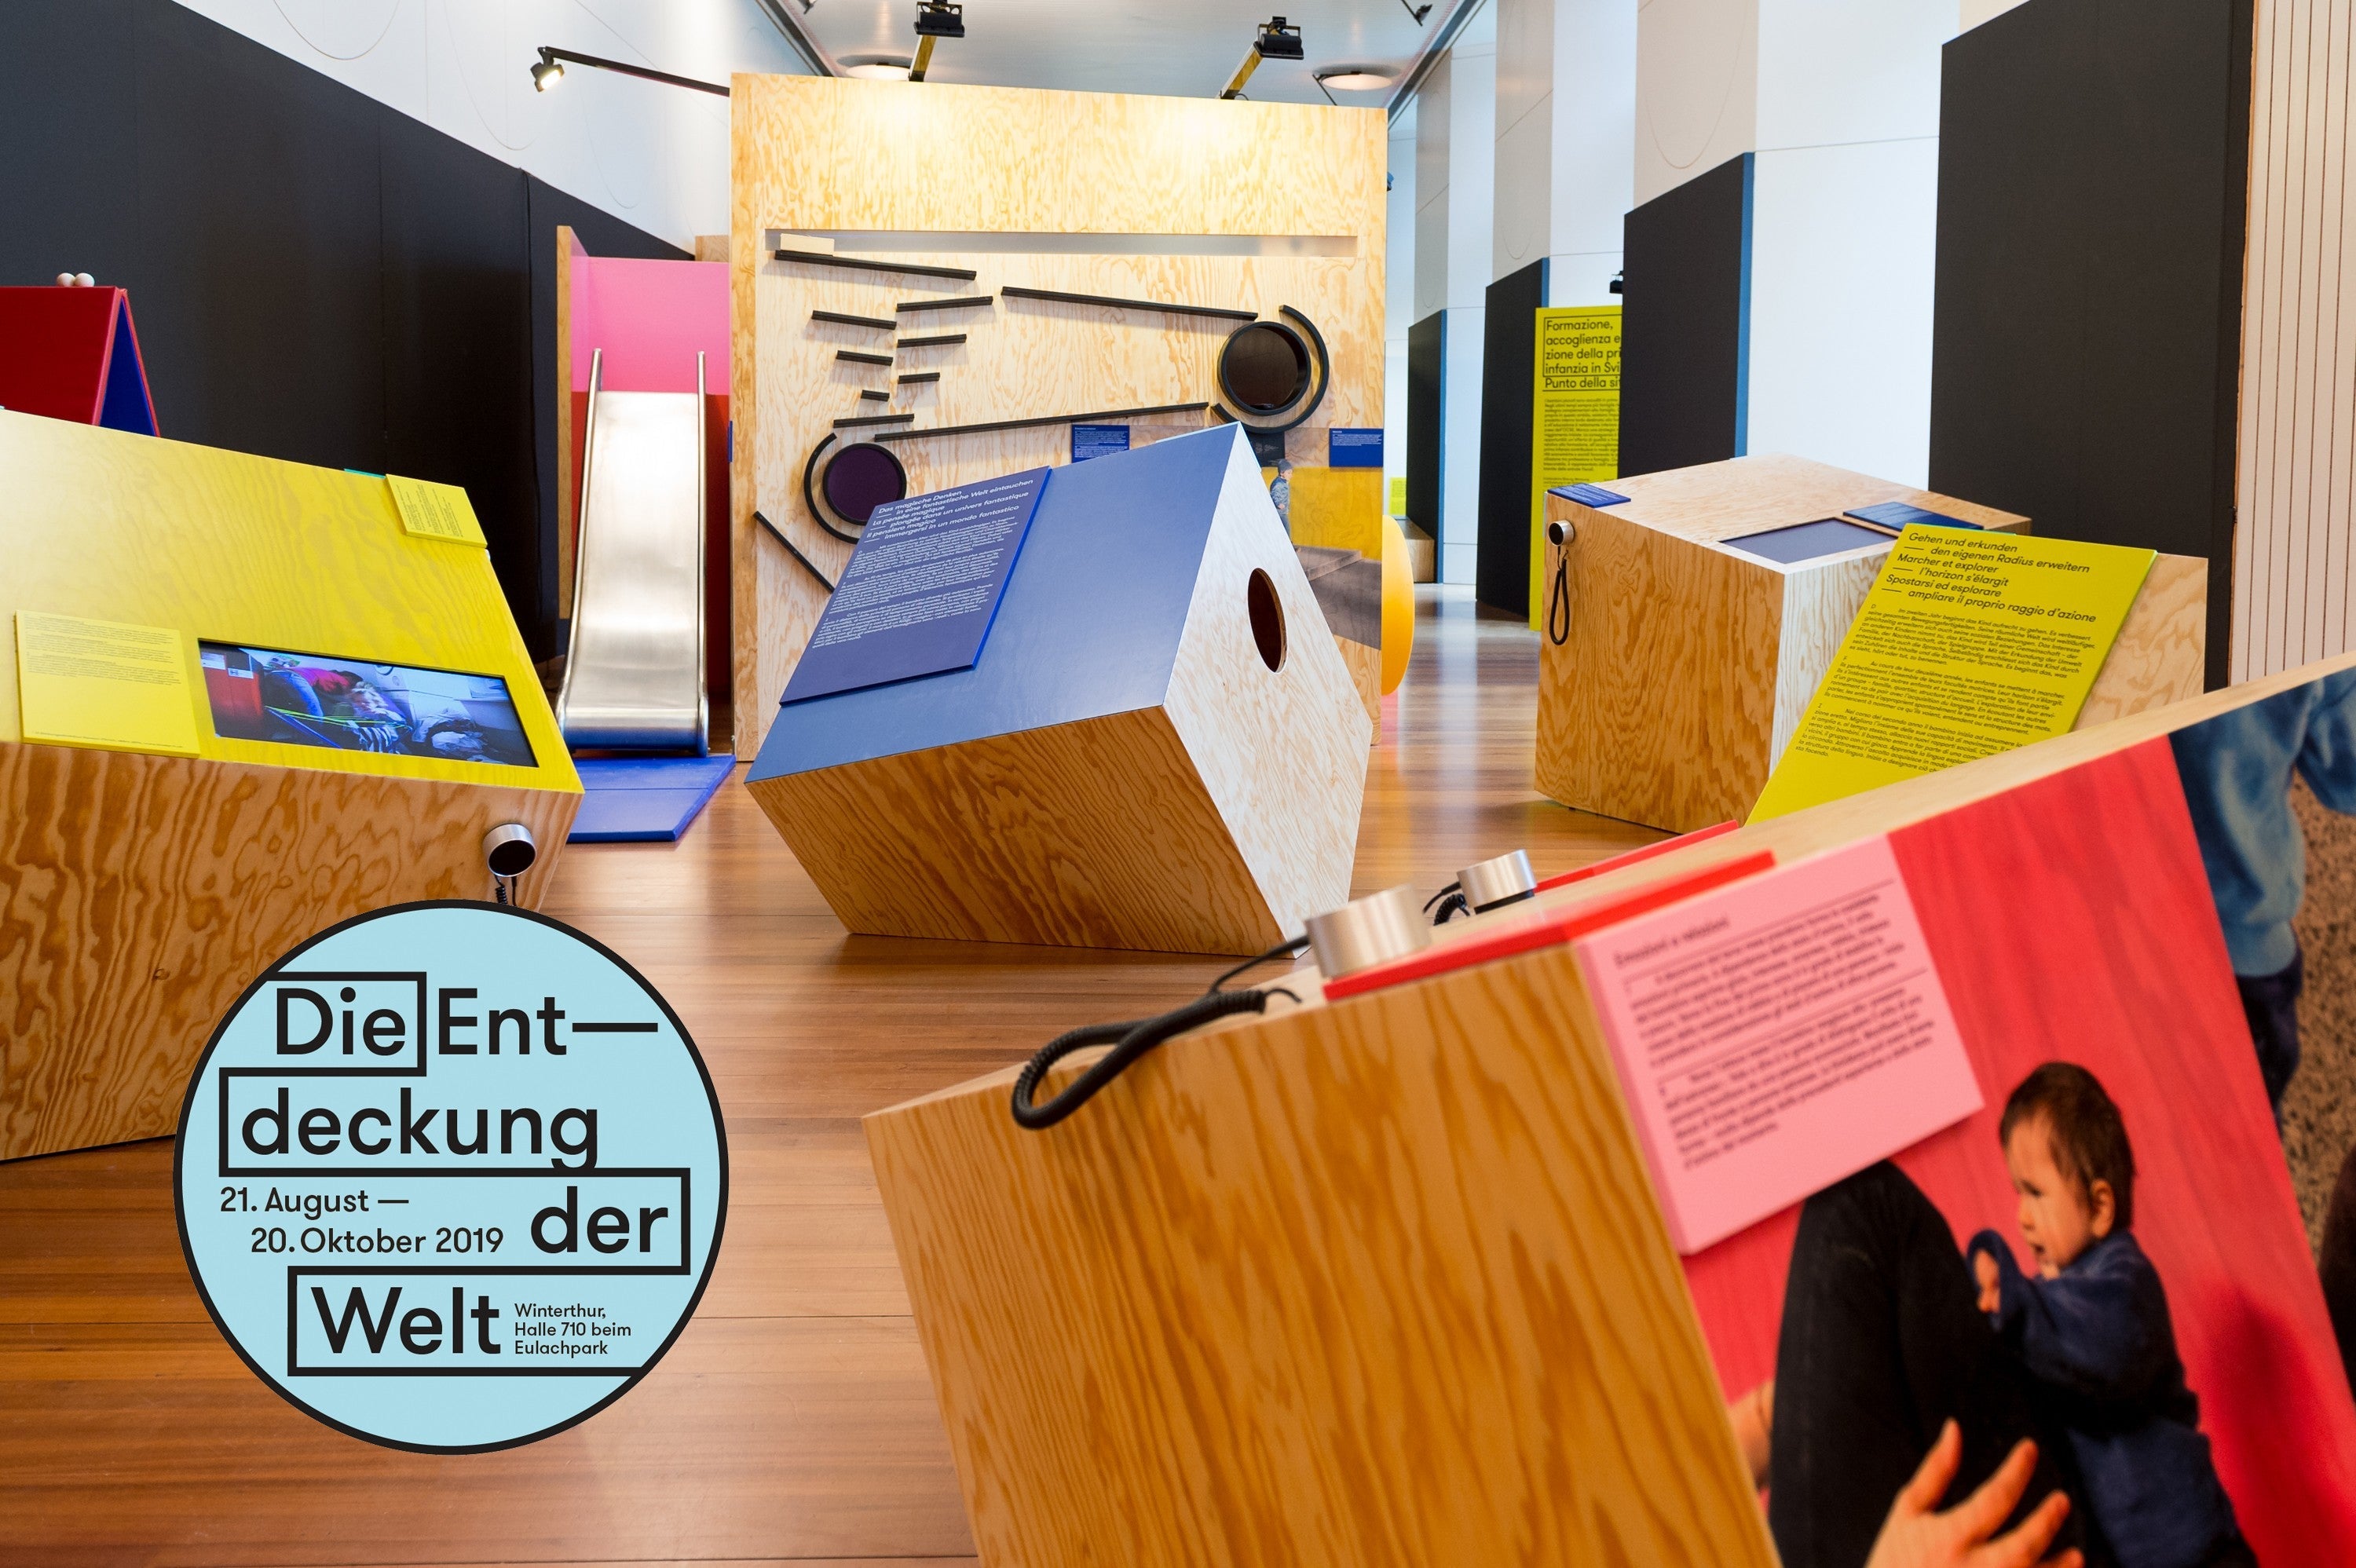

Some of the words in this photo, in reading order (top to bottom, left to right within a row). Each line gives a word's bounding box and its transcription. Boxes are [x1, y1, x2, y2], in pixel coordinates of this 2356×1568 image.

[1546, 319, 1613, 331] Formazione,
[1546, 333, 1611, 348] accoglienza
[1545, 349, 1574, 360] zione
[1576, 348, 1603, 359] della
[1545, 363, 1589, 374] infanzia
[1591, 362, 1601, 373] in
[1545, 378, 1577, 388] Punto
[1579, 376, 1606, 388] della
[971, 489, 989, 498] Welt
[990, 480, 1033, 493] eintauchen
[895, 498, 931, 510] magische
[933, 491, 962, 501] Denken
[954, 503, 982, 512] univers
[983, 492, 1029, 506] fantastique
[907, 519, 936, 528] magico
[949, 515, 977, 524] mondo
[979, 505, 1019, 518] fantastico
[1908, 532, 1943, 543] Gehen
[1944, 538, 1967, 546] und
[1967, 540, 2018, 552] erkunden
[1897, 553, 1941, 565] Marcher
[1955, 562, 1999, 573] explorer
[1930, 546, 1951, 556] den
[1952, 549, 1995, 561] eigenen
[1996, 554, 2034, 566] Radius
[2036, 561, 2090, 572] erweitern
[1886, 574, 1935, 588] Spostarsi
[1934, 581, 1951, 590] ed
[1951, 585, 2002, 598] esplorare
[1919, 567, 1964, 580] l’horizon
[1965, 573, 2009, 587] s’élargit
[1908, 590, 1955, 602] ampliare
[1955, 594, 1965, 604] il
[1963, 598, 2006, 609] proprio
[2007, 604, 2045, 616] raggio
[2047, 608, 2096, 622] d’azione
